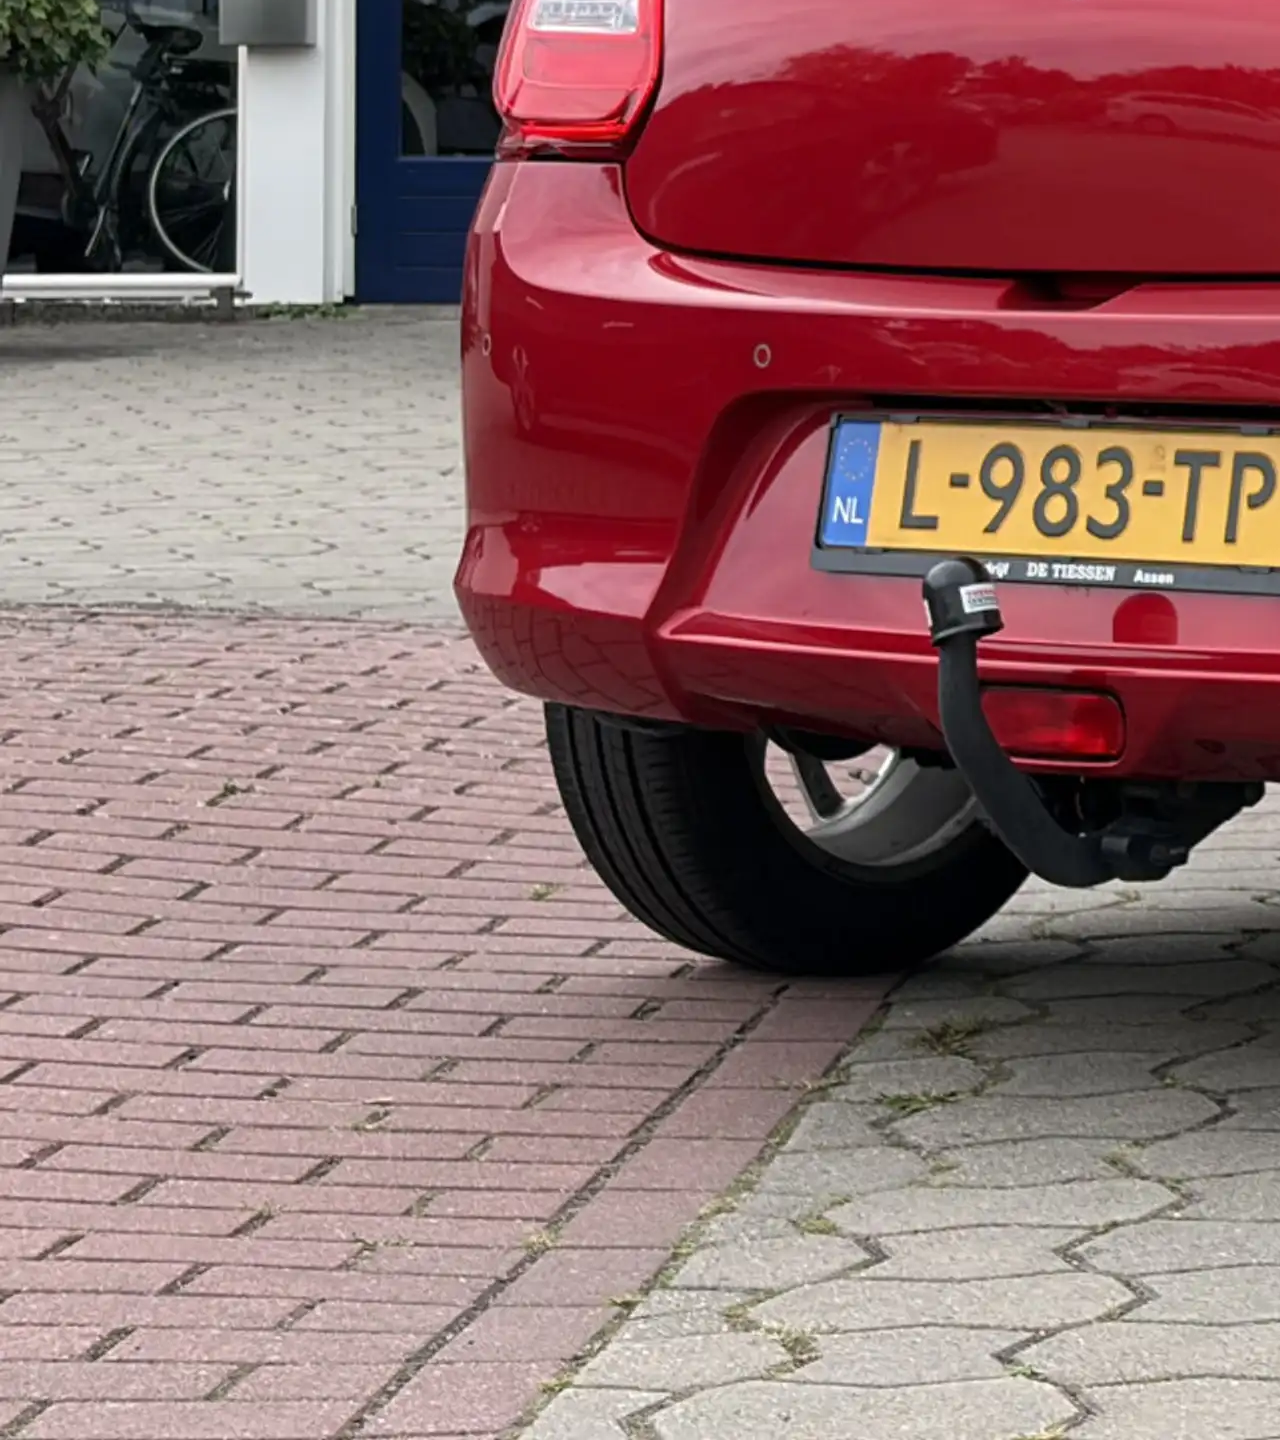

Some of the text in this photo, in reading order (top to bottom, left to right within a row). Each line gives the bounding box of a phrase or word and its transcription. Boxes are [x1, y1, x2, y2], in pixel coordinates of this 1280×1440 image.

[899, 439, 1278, 544] L-983-TP
[833, 497, 865, 526] NL
[1026, 562, 1049, 578] DE
[1051, 562, 1117, 582] TIESSEN
